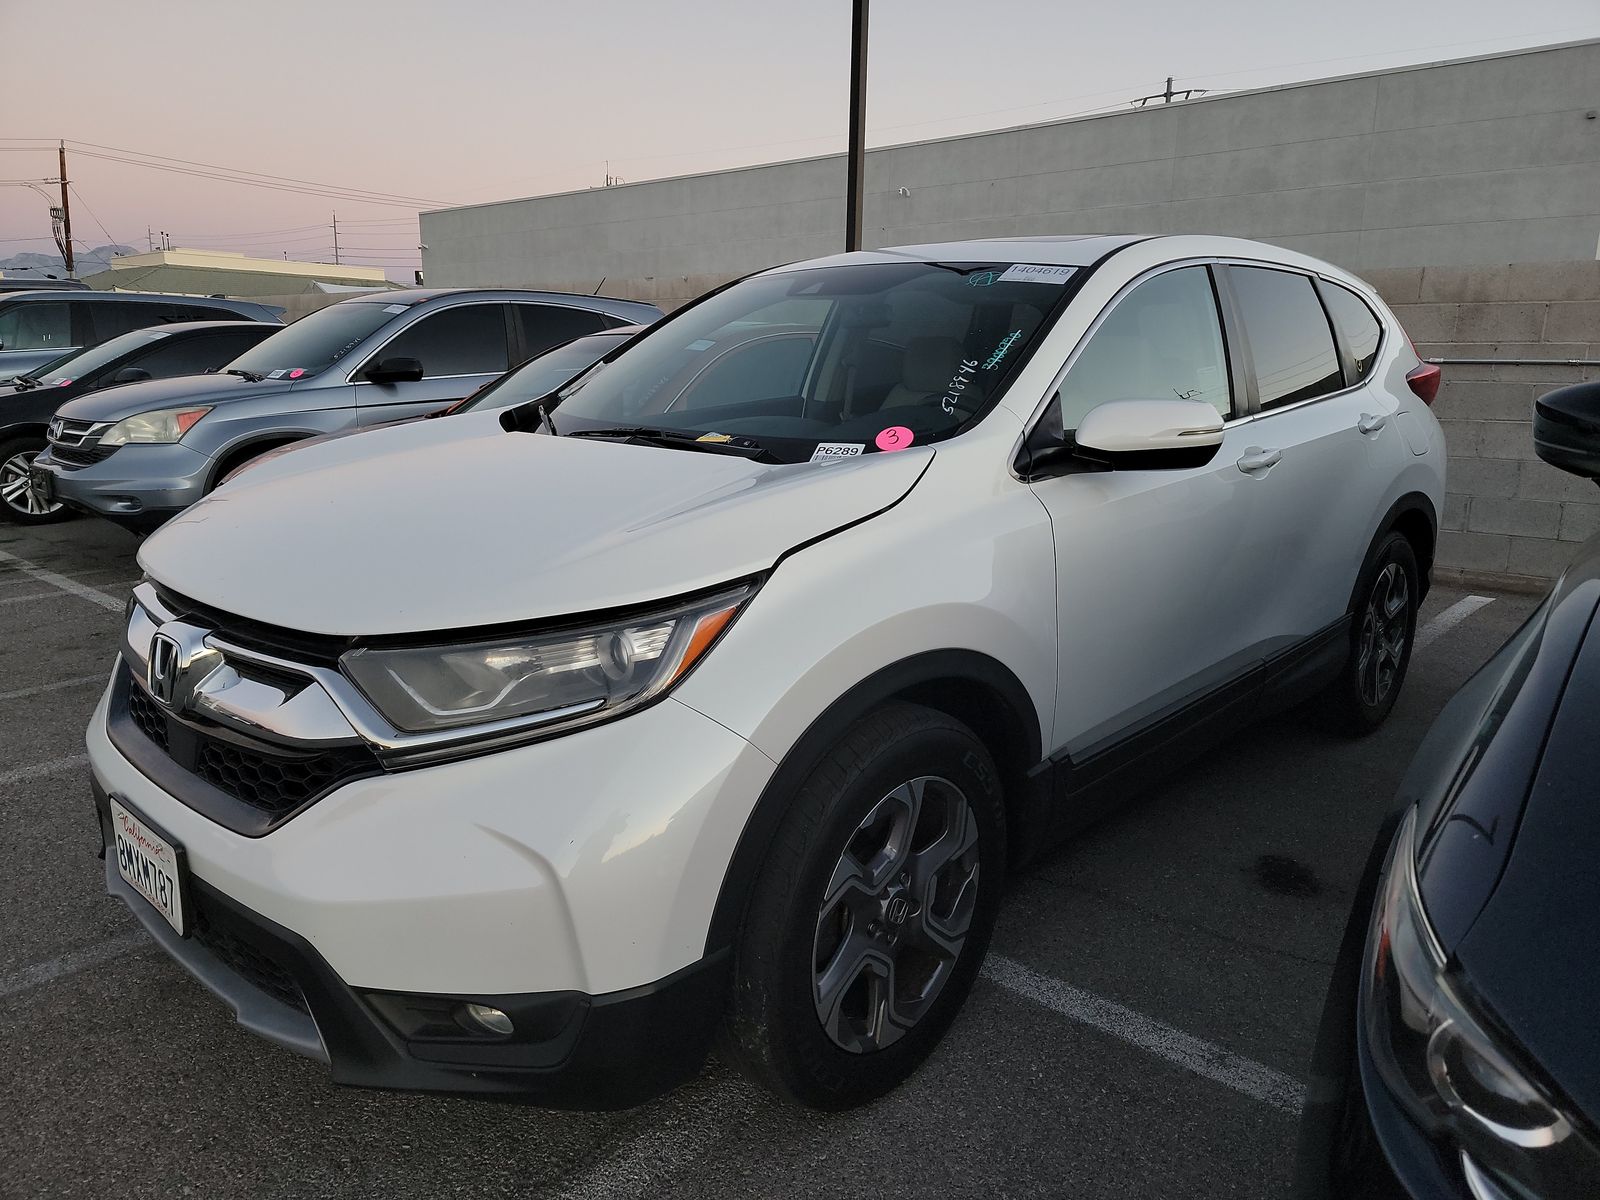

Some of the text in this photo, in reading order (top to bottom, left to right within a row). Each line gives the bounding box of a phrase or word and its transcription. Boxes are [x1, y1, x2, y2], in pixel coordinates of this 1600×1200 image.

[1011, 265, 1071, 276] 1404619
[886, 429, 900, 444] 3
[815, 446, 859, 456] P6289
[123, 814, 164, 856] California
